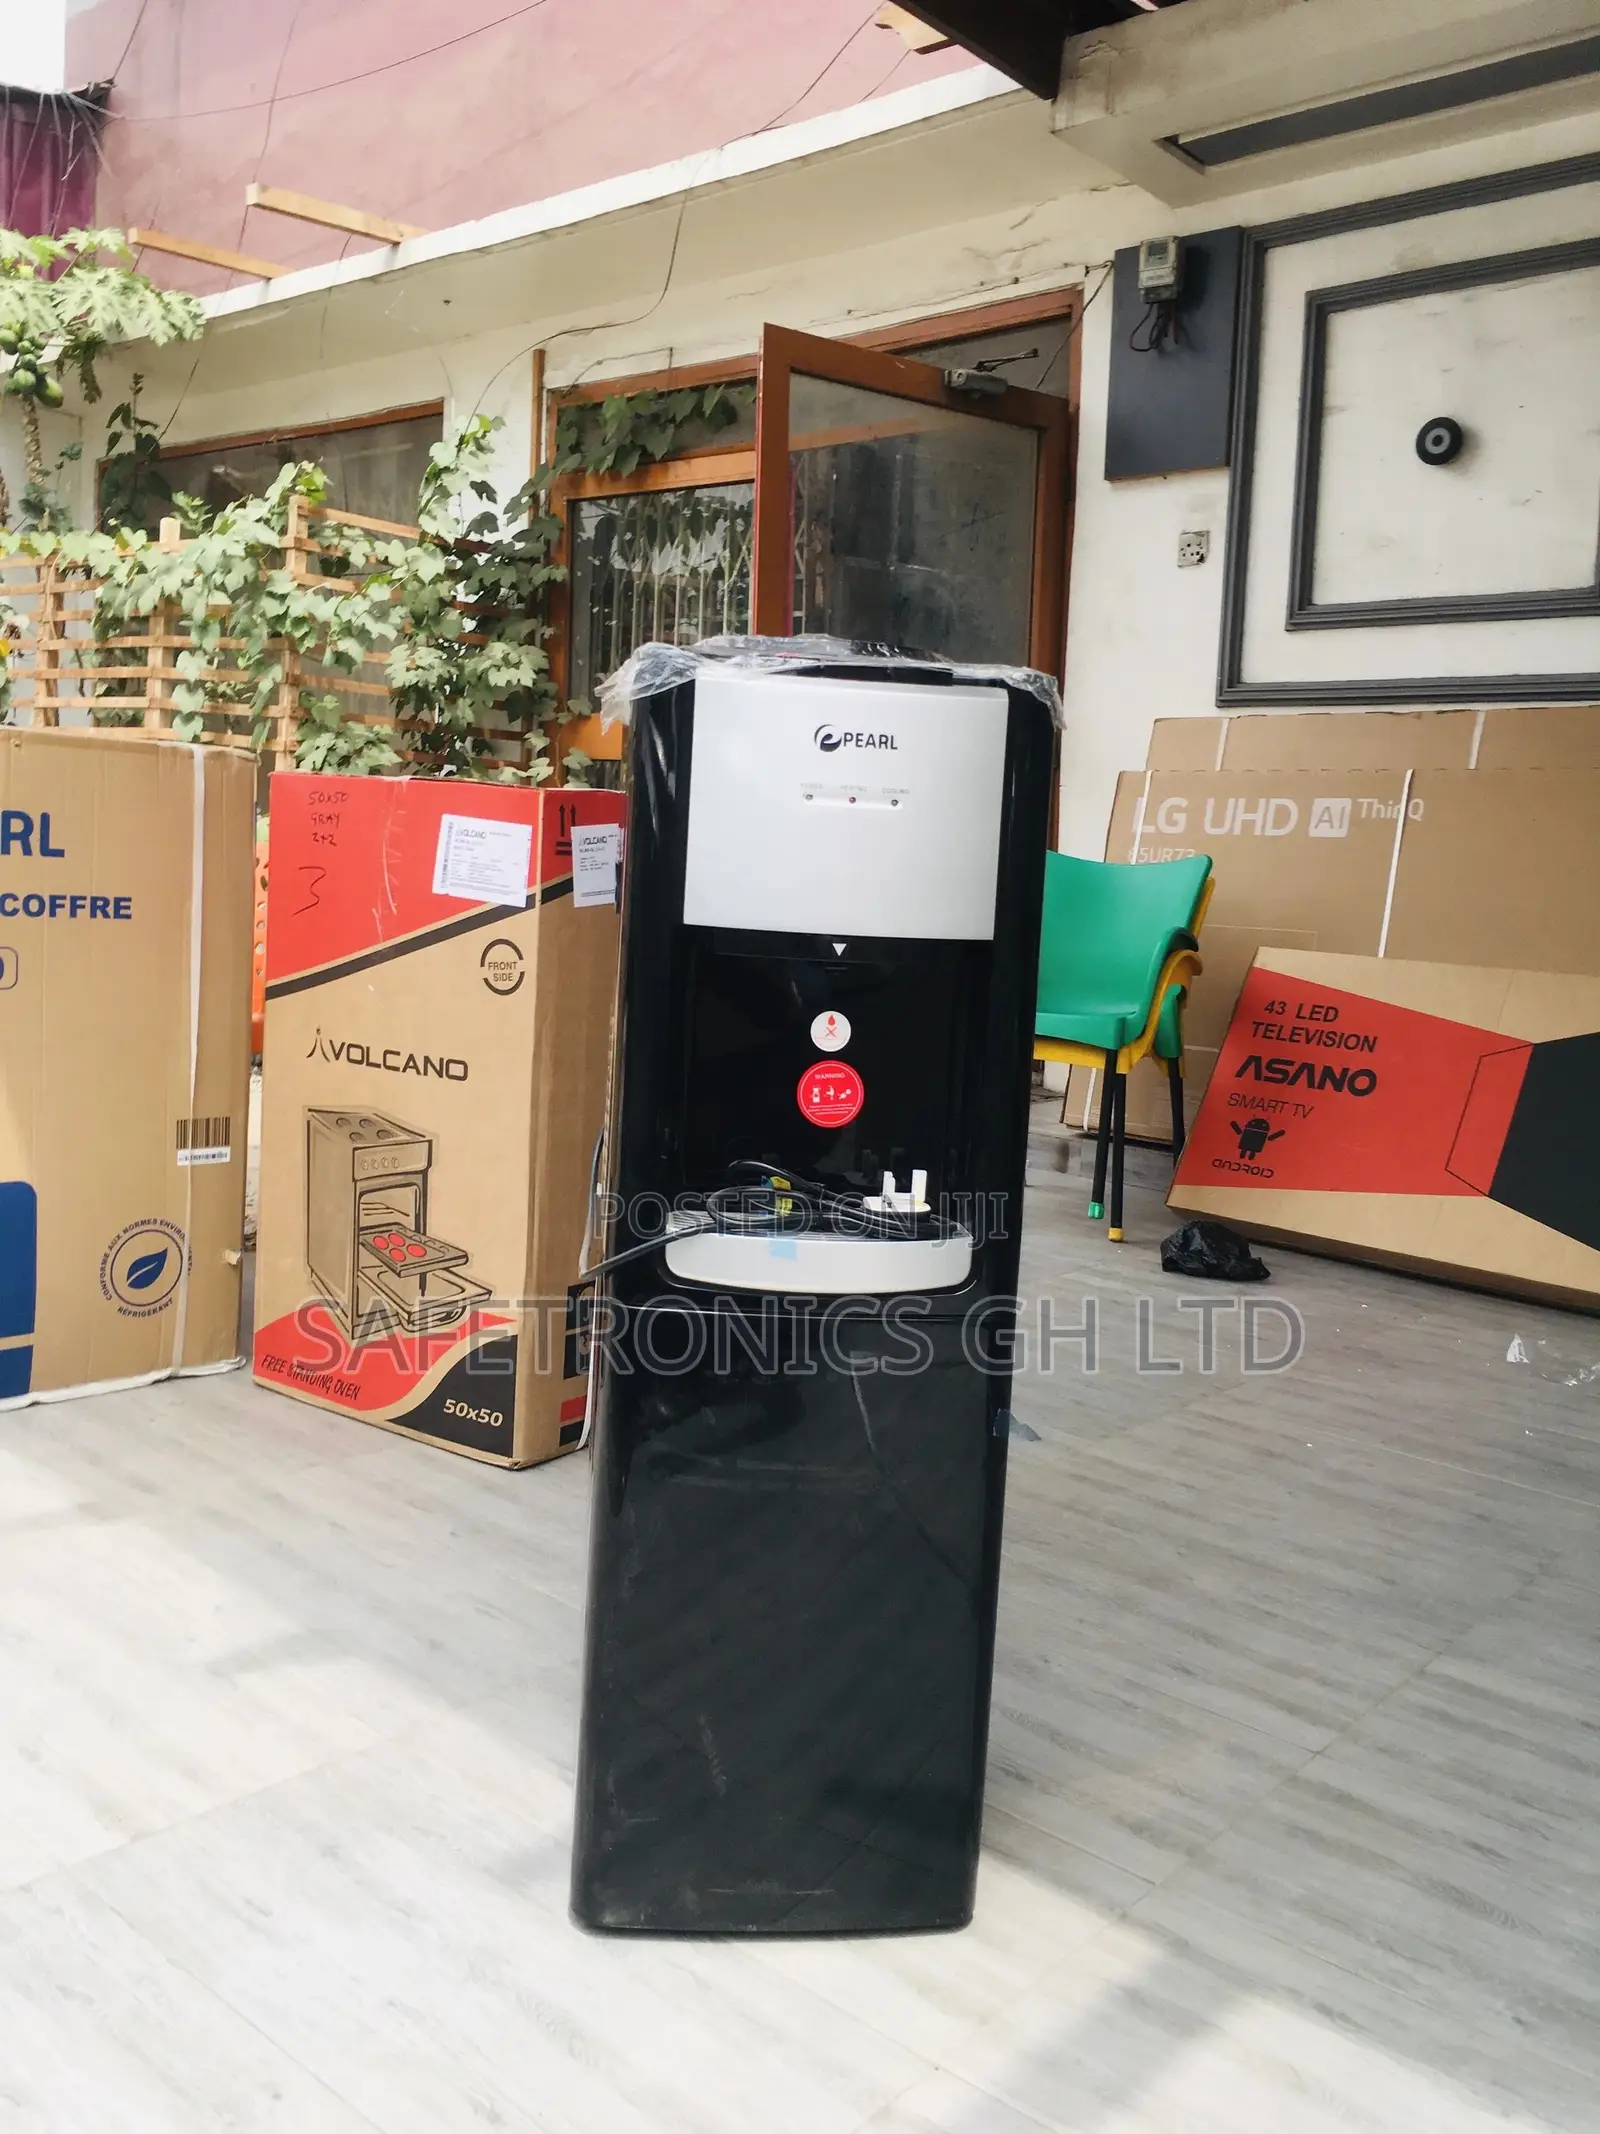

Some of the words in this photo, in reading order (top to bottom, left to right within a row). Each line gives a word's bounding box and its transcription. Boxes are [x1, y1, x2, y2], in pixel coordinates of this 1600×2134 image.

[843, 732, 898, 750] PEARL
[1132, 797, 1188, 834] LG
[1203, 797, 1298, 836] UHD
[1313, 805, 1347, 830] AI
[0, 892, 133, 920] COFFRE
[488, 961, 518, 972] FRONT
[492, 972, 514, 982] SIDE
[1263, 999, 1288, 1016] 43
[1294, 1002, 1340, 1023] LED
[1251, 1020, 1378, 1053] TELEVISION
[329, 1039, 469, 1082] VOLCANO
[1234, 1054, 1378, 1097] ASANO
[1227, 1091, 1289, 1114] SMART
[1291, 1103, 1315, 1119] TV
[99, 1252, 113, 1301] CONFORME
[107, 1234, 122, 1251] AUX
[122, 1218, 158, 1237] NORMES
[261, 1354, 288, 1374] FREE
[287, 1363, 334, 1394] STANDING
[333, 1379, 362, 1400] OVEN
[443, 1398, 504, 1427] 50x50
